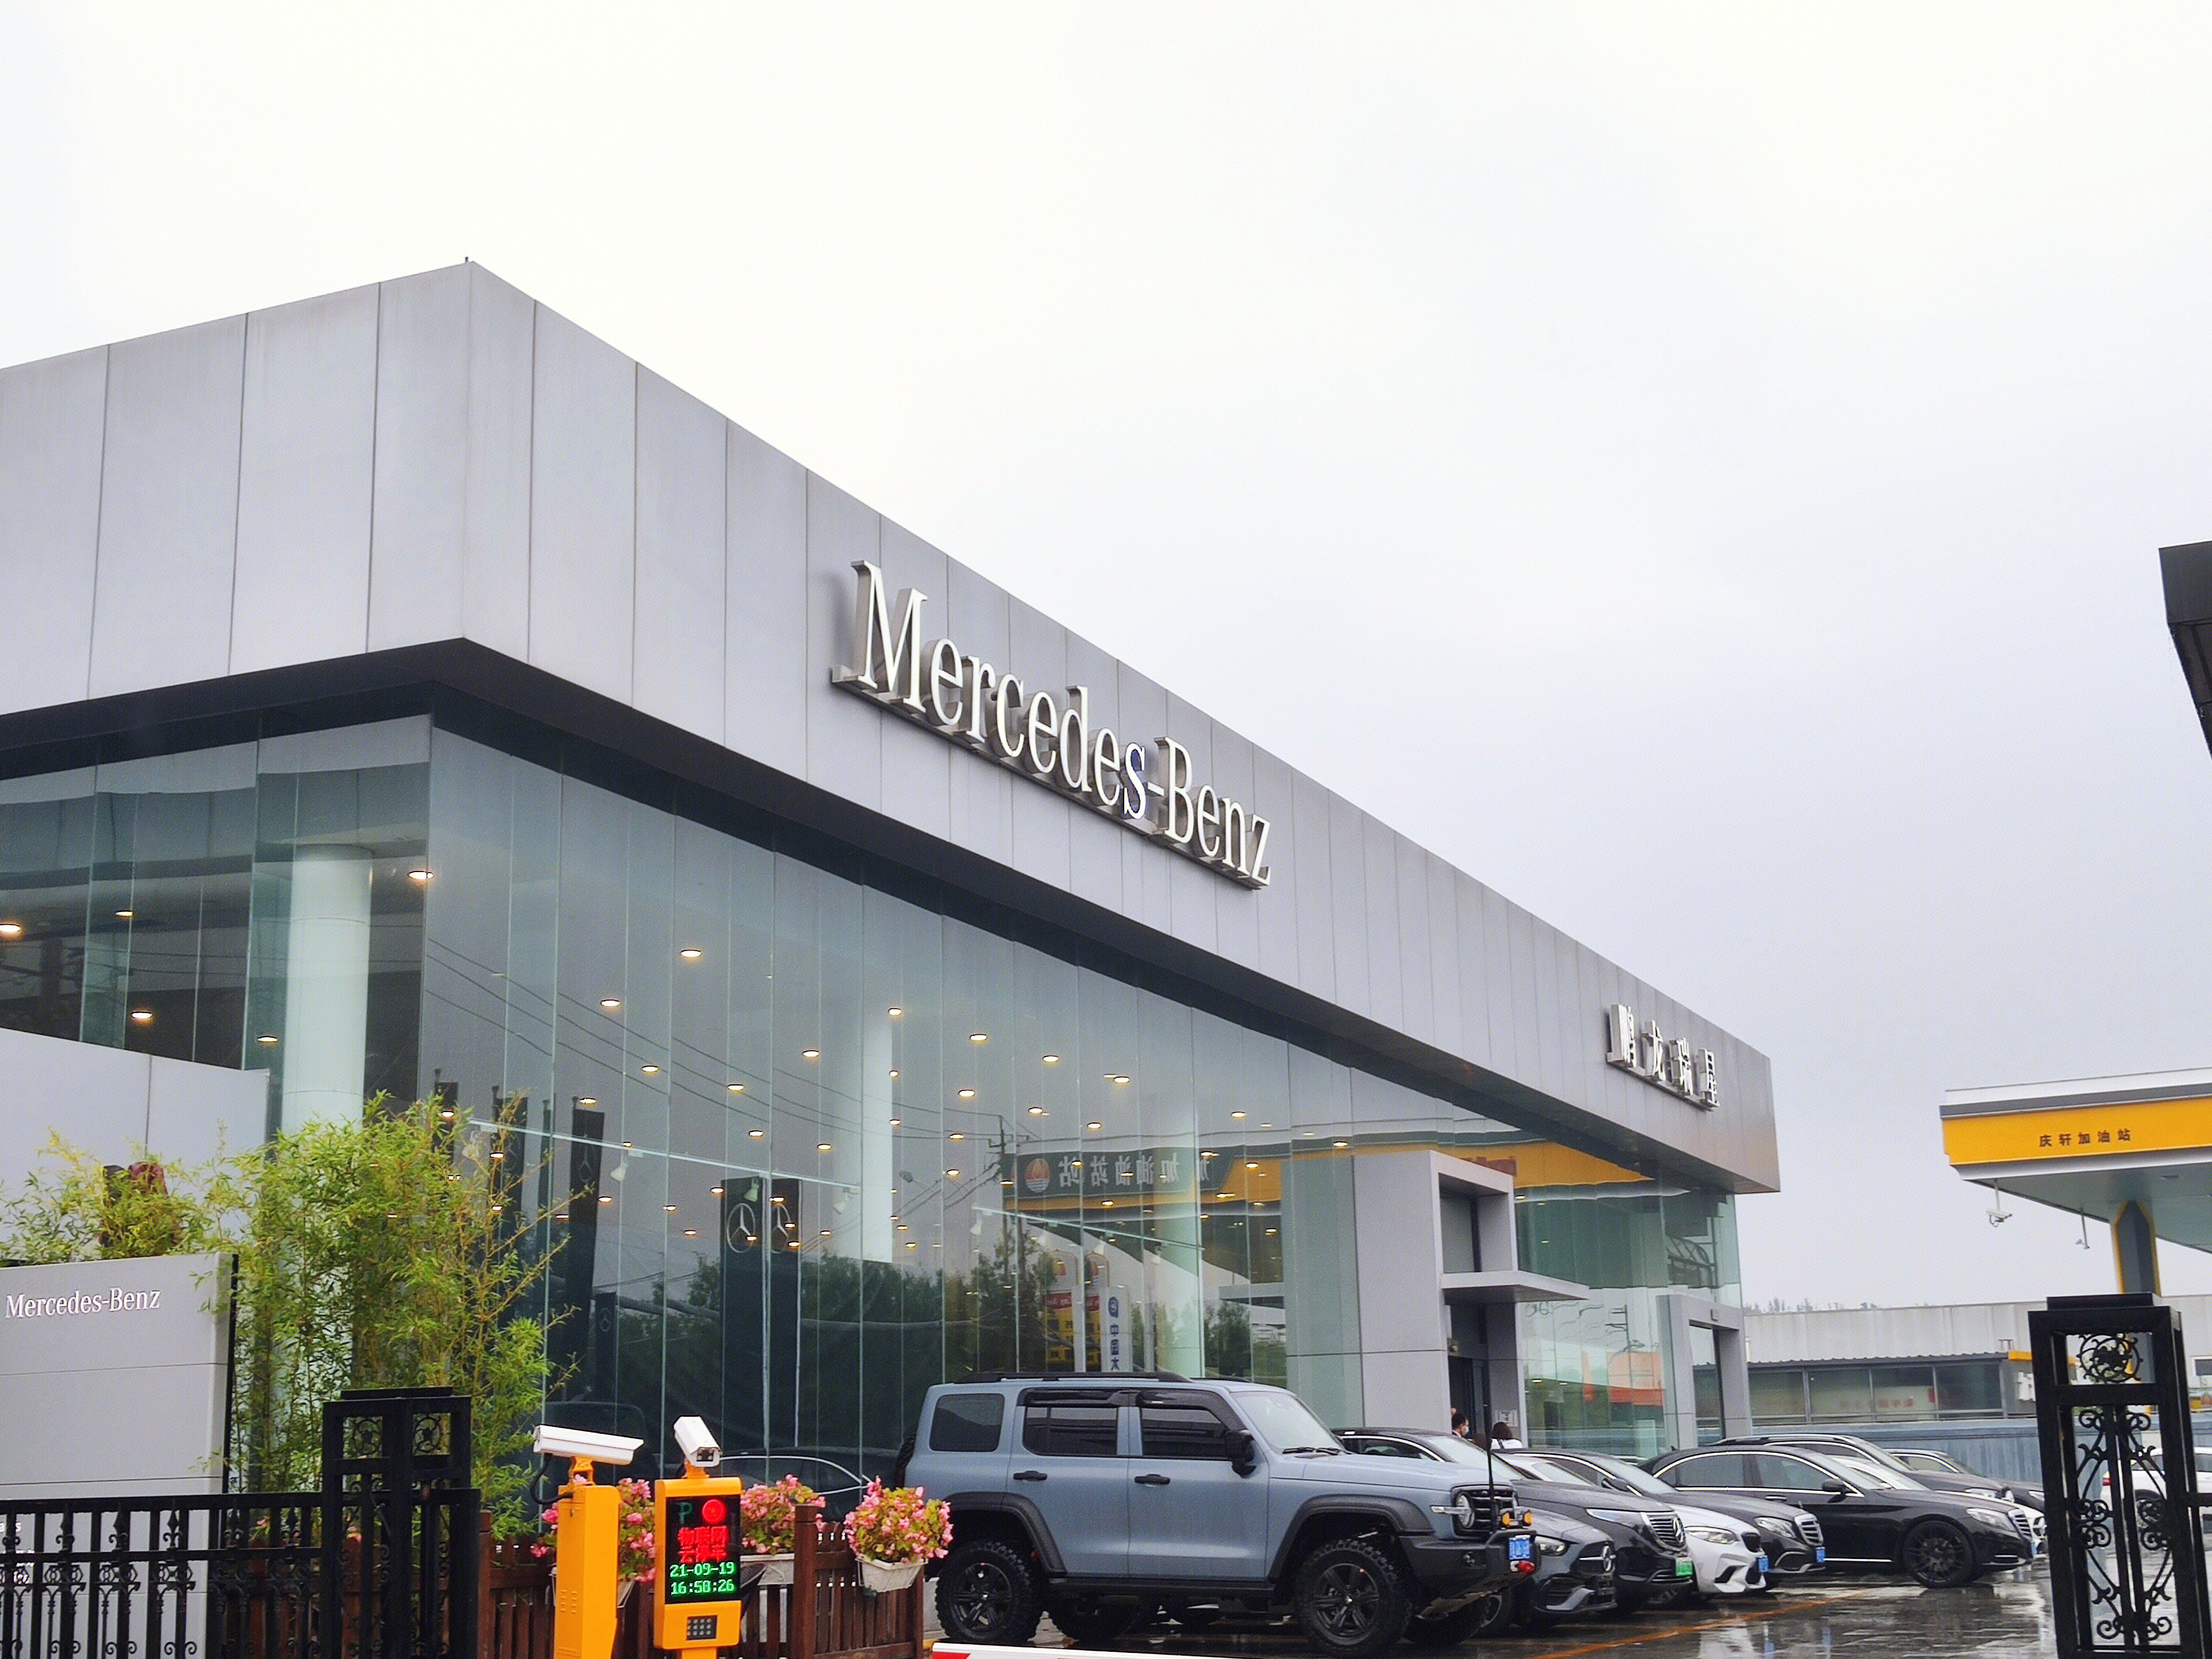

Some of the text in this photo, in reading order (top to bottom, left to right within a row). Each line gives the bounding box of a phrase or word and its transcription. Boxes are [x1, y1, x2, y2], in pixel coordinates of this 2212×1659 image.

[851, 560, 1271, 887] Mercedes-Benz
[2039, 1128, 2131, 1147] 庆轩加油站
[5, 1287, 161, 1319] Mercedes-Benz
[677, 1525, 728, 1547] 物联网
[669, 1562, 735, 1577] 21-09-19
[671, 1578, 735, 1595] 16:50:26
